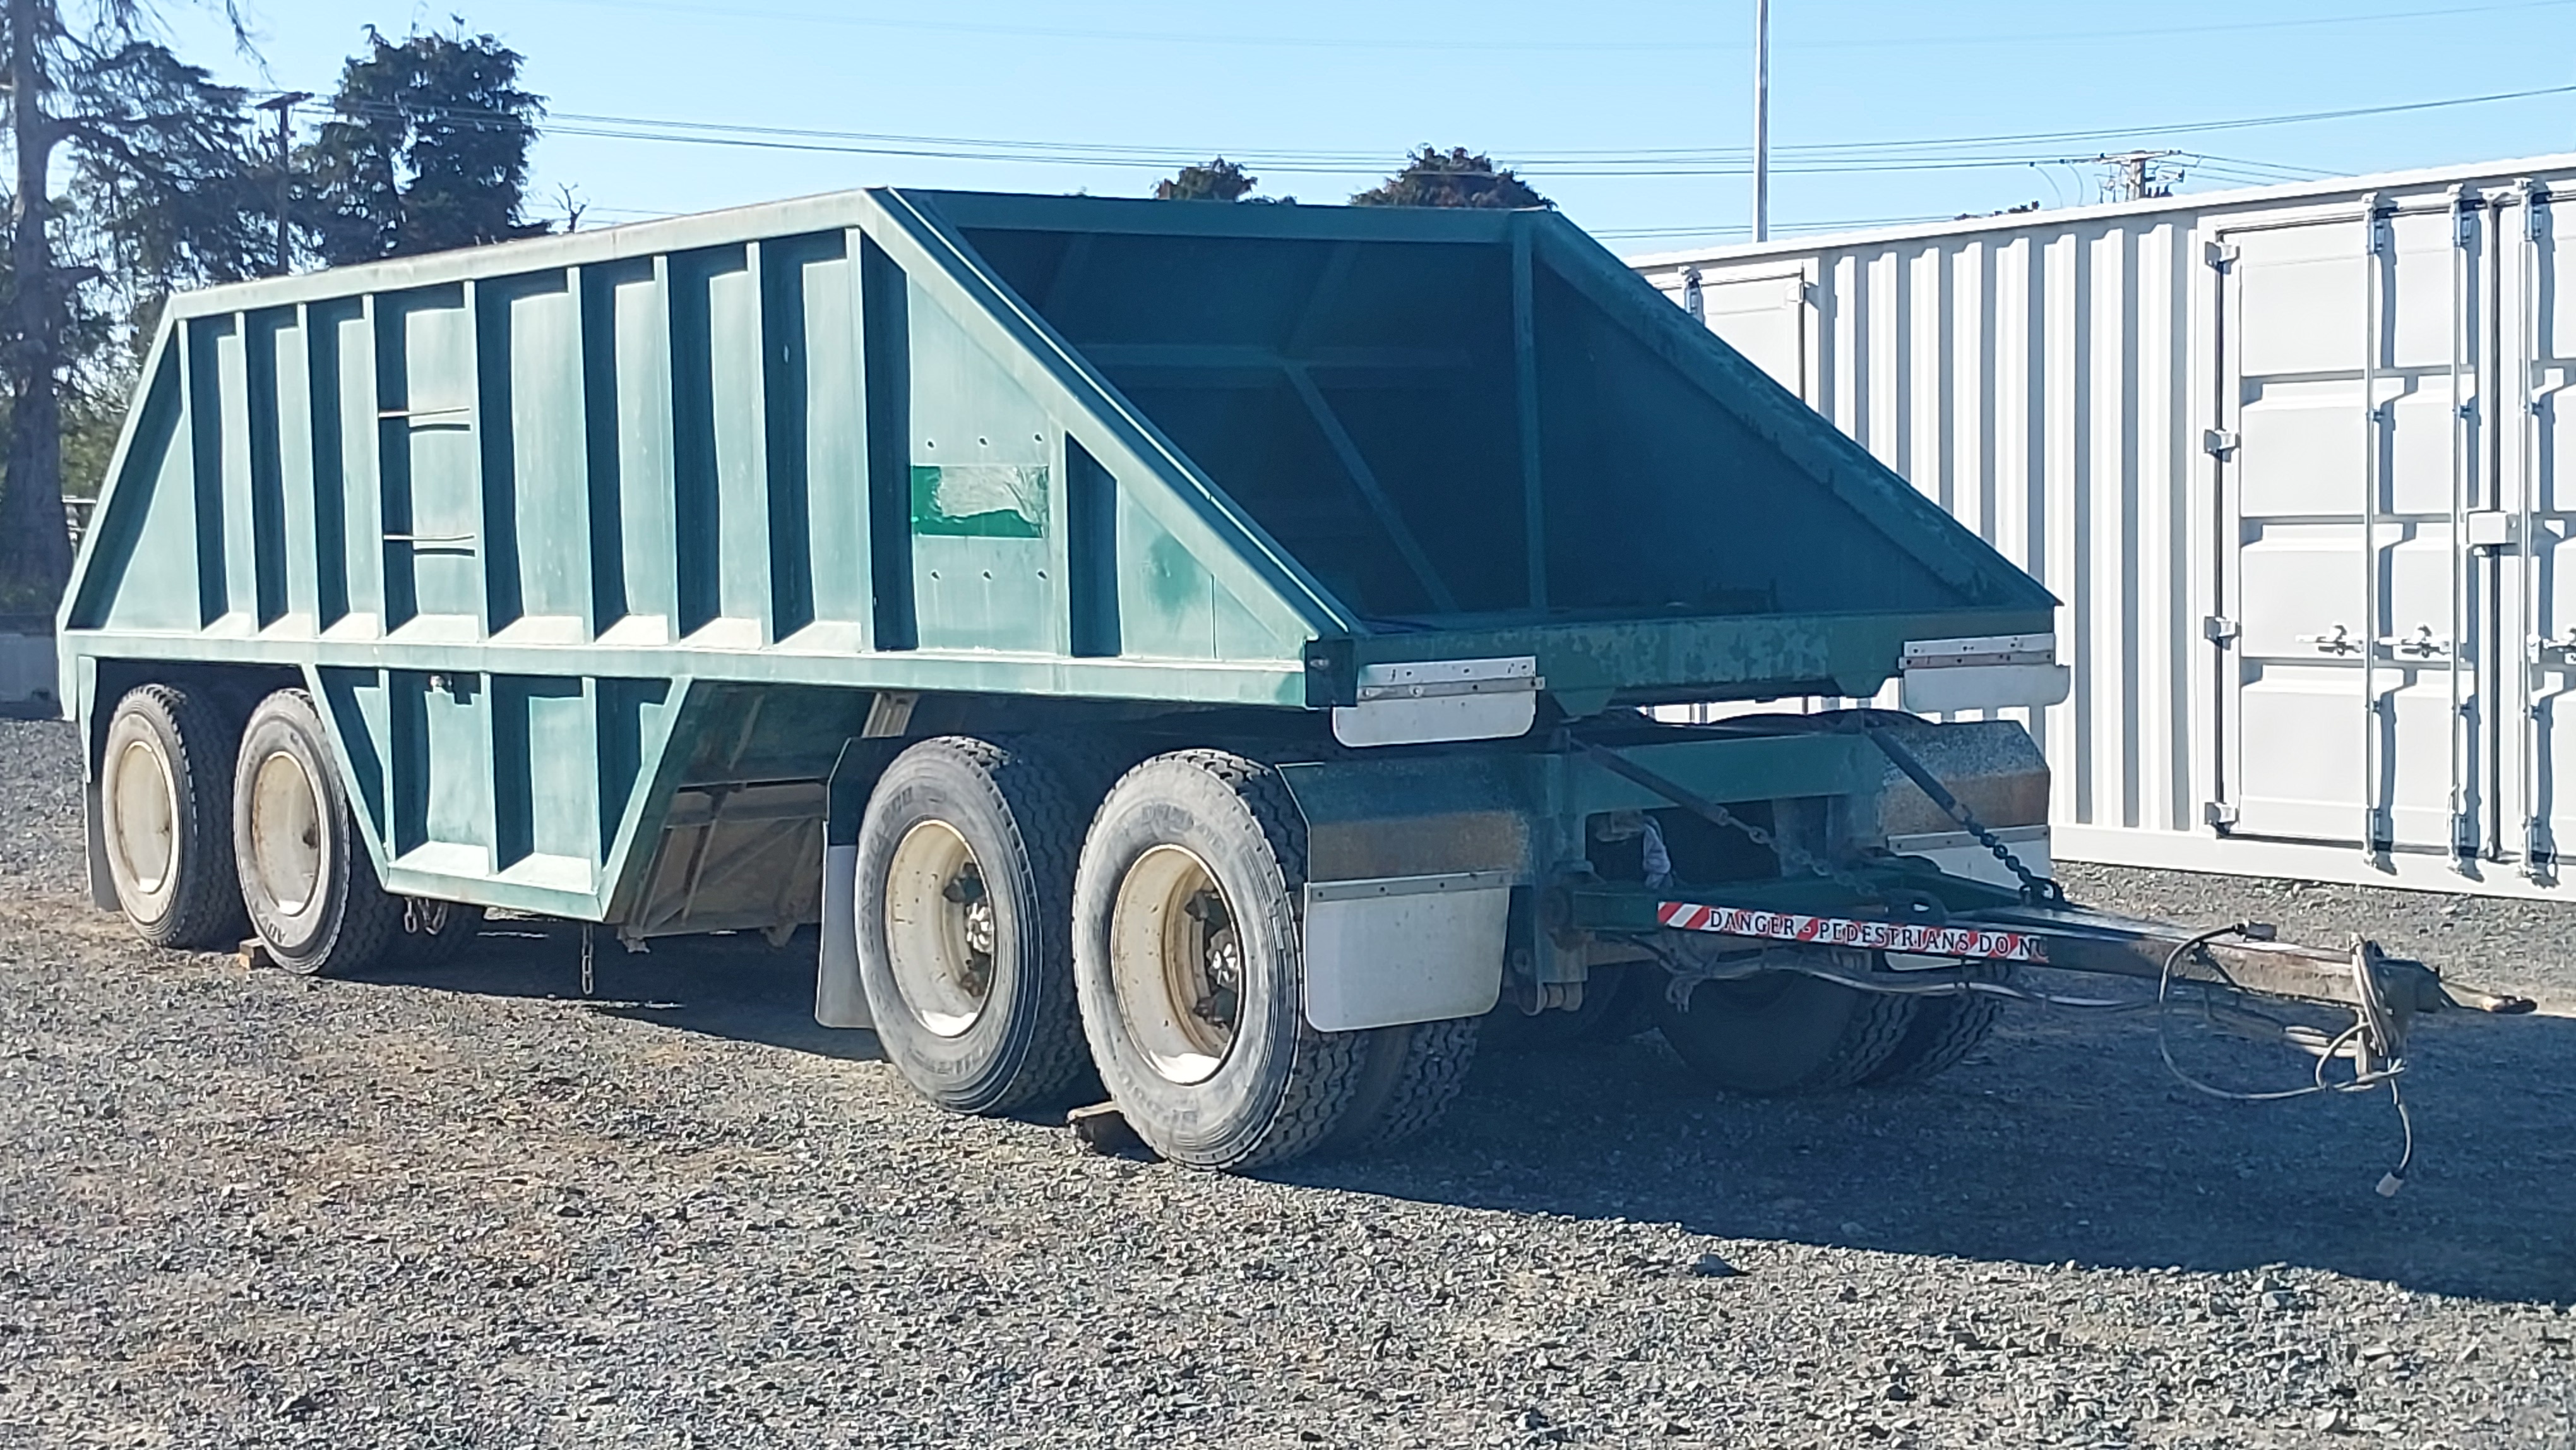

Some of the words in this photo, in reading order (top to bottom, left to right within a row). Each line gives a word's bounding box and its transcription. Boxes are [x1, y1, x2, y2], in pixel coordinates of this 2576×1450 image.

[1710, 910, 1795, 936] DANGER
[1819, 921, 1969, 951] PEDESTRIANS
[1979, 934, 2009, 954] DO
